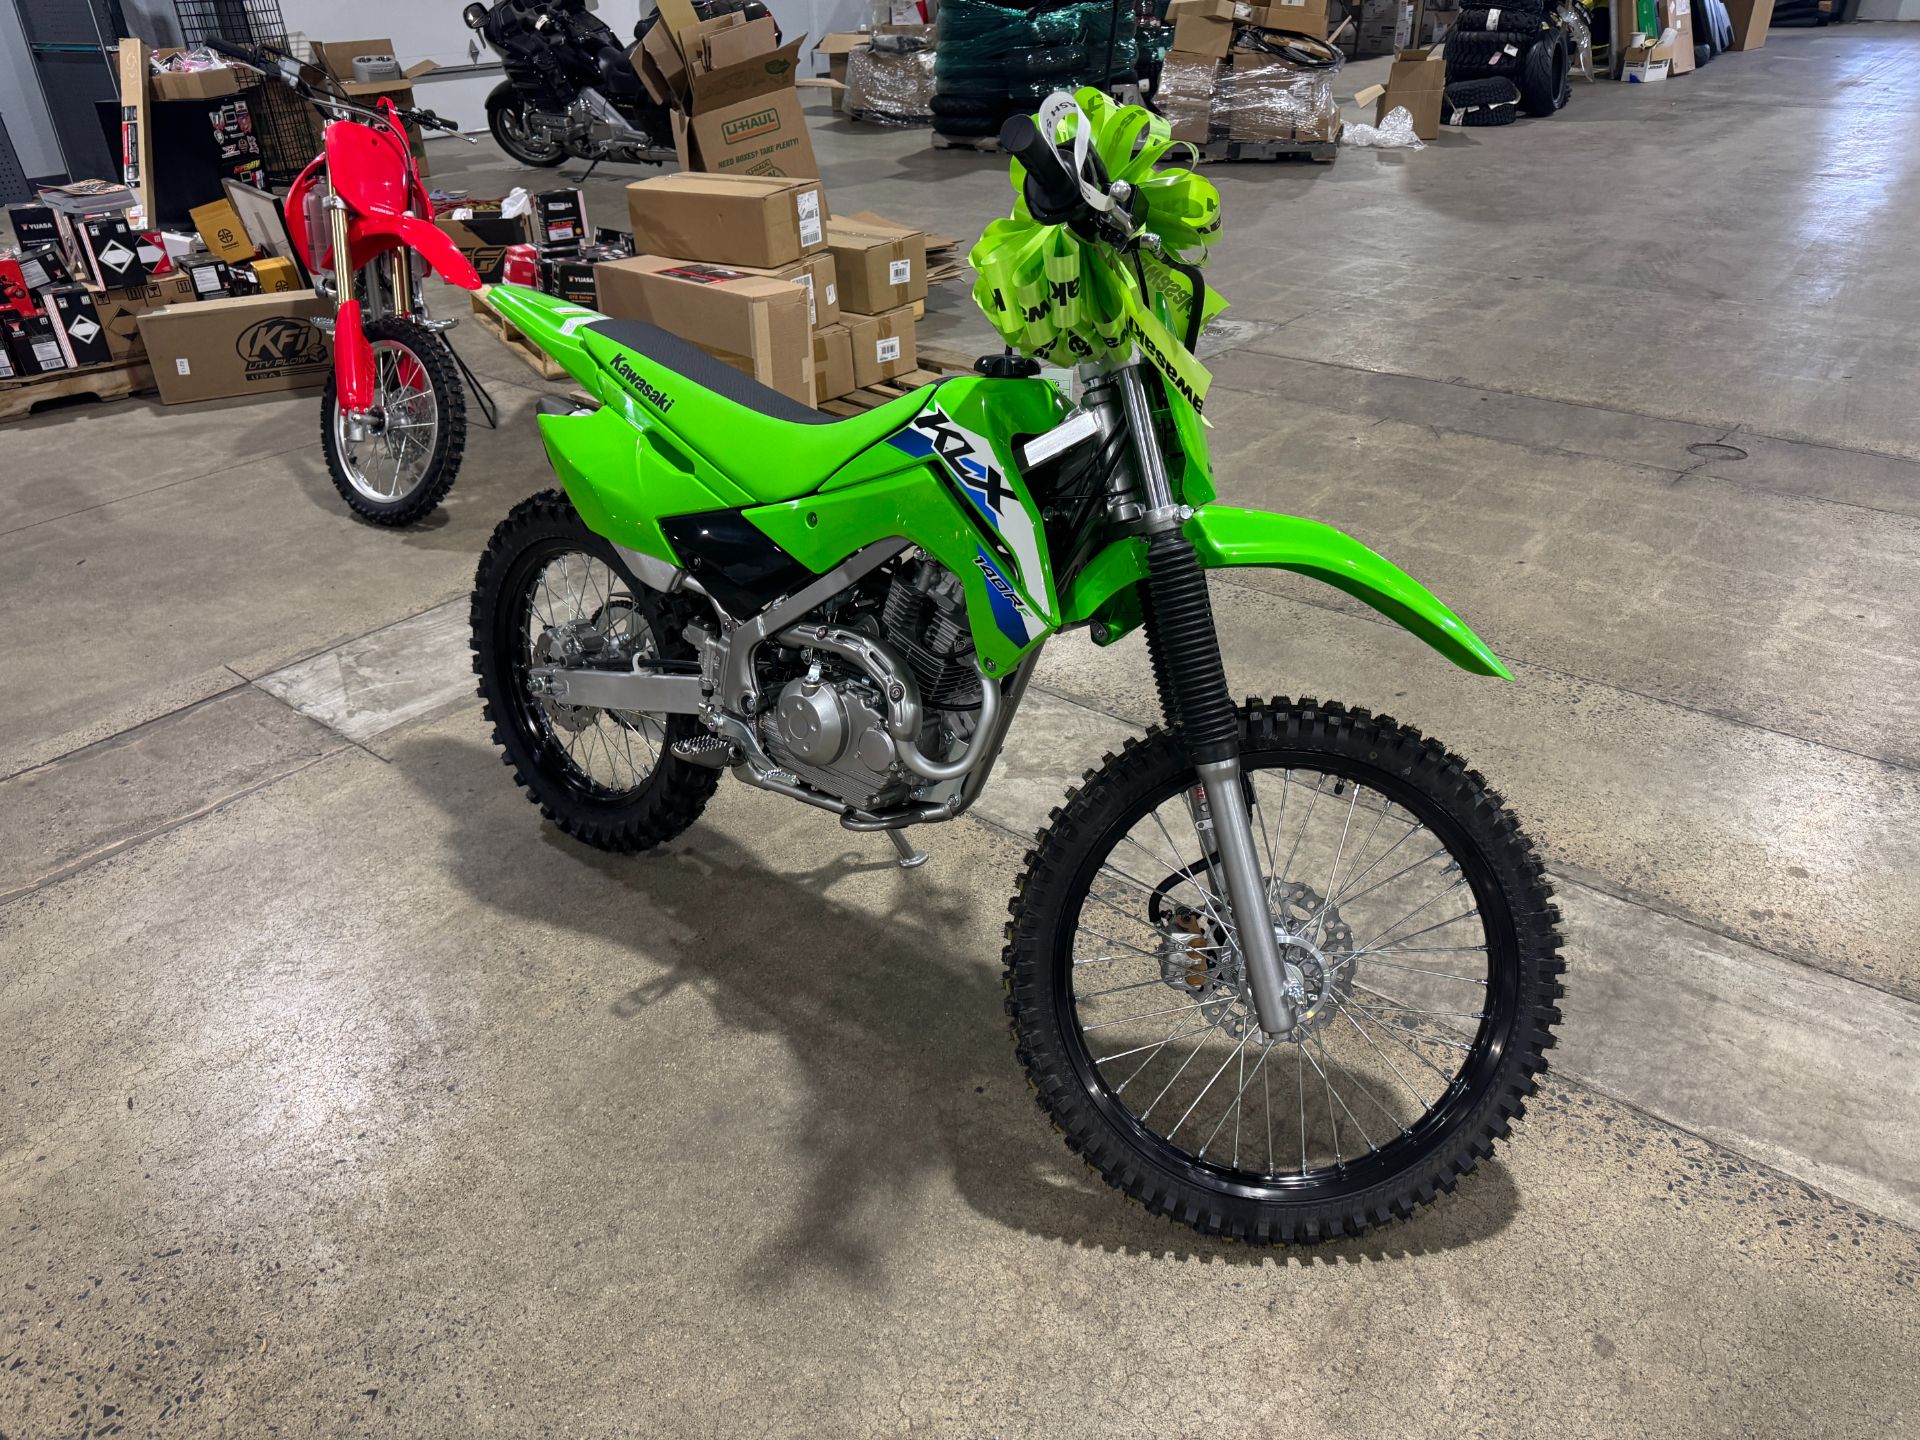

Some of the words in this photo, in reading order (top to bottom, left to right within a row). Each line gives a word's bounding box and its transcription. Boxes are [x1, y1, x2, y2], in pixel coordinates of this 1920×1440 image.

[725, 112, 776, 135] U-HAUL
[718, 158, 734, 169] NEED
[736, 150, 759, 163] BOXES?
[760, 145, 774, 156] TAKE
[776, 138, 799, 150] PLENTY!
[28, 222, 53, 230] YUASA
[248, 359, 274, 370] UTV
[275, 356, 308, 368] PLOW
[609, 352, 676, 414] Kawasaki
[914, 406, 1021, 518] KLX
